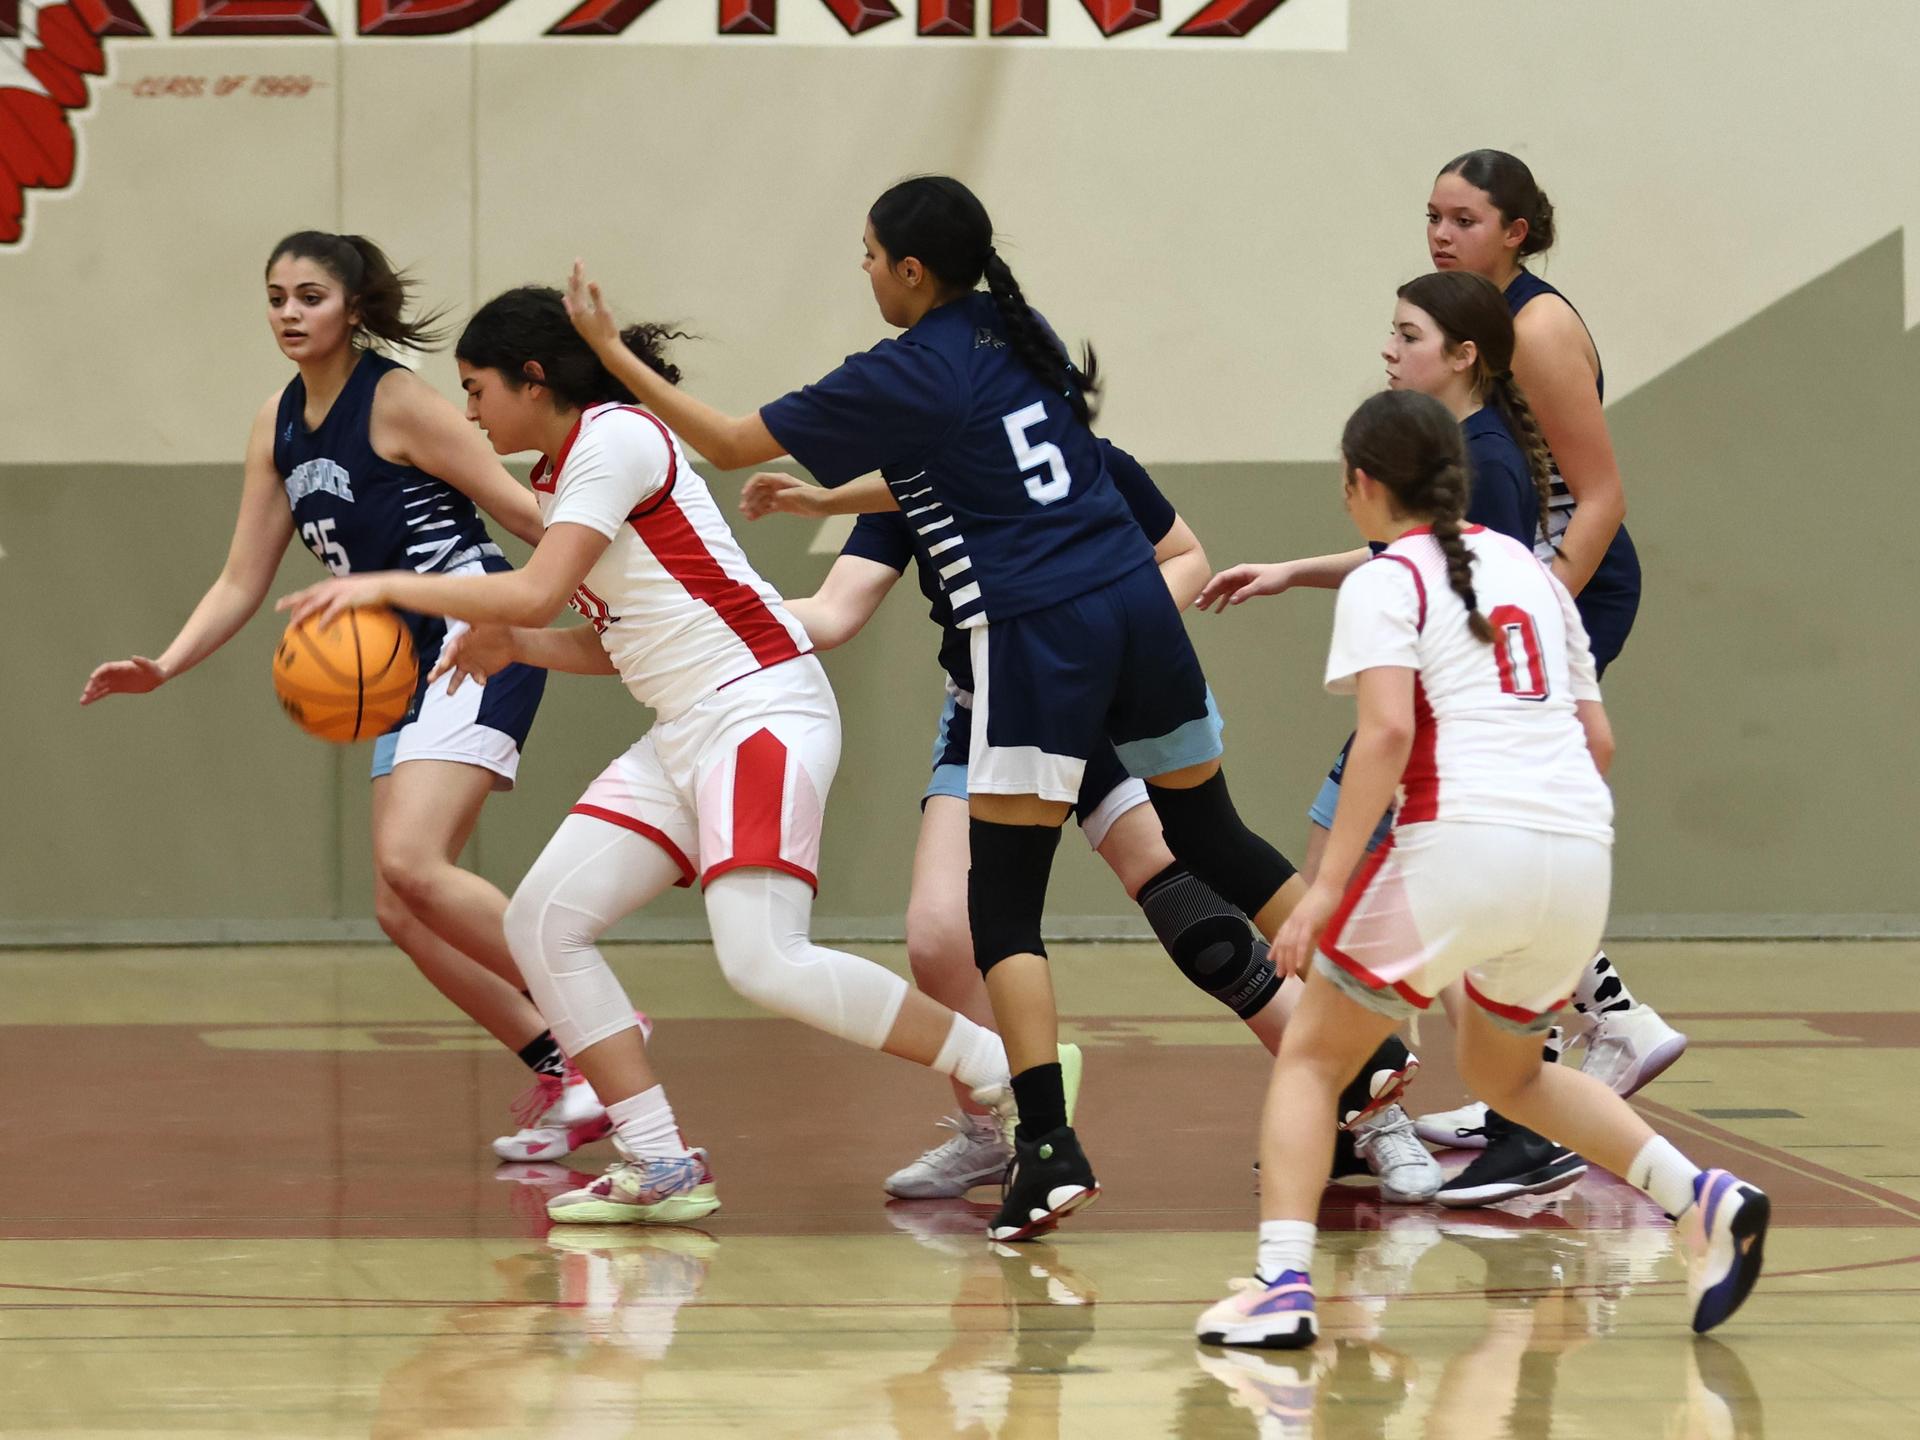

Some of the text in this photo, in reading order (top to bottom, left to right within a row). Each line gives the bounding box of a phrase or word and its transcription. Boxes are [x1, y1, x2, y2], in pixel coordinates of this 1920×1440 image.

[213, 75, 248, 97] OF
[1002, 400, 1072, 506] 5
[1488, 604, 1550, 702] 0
